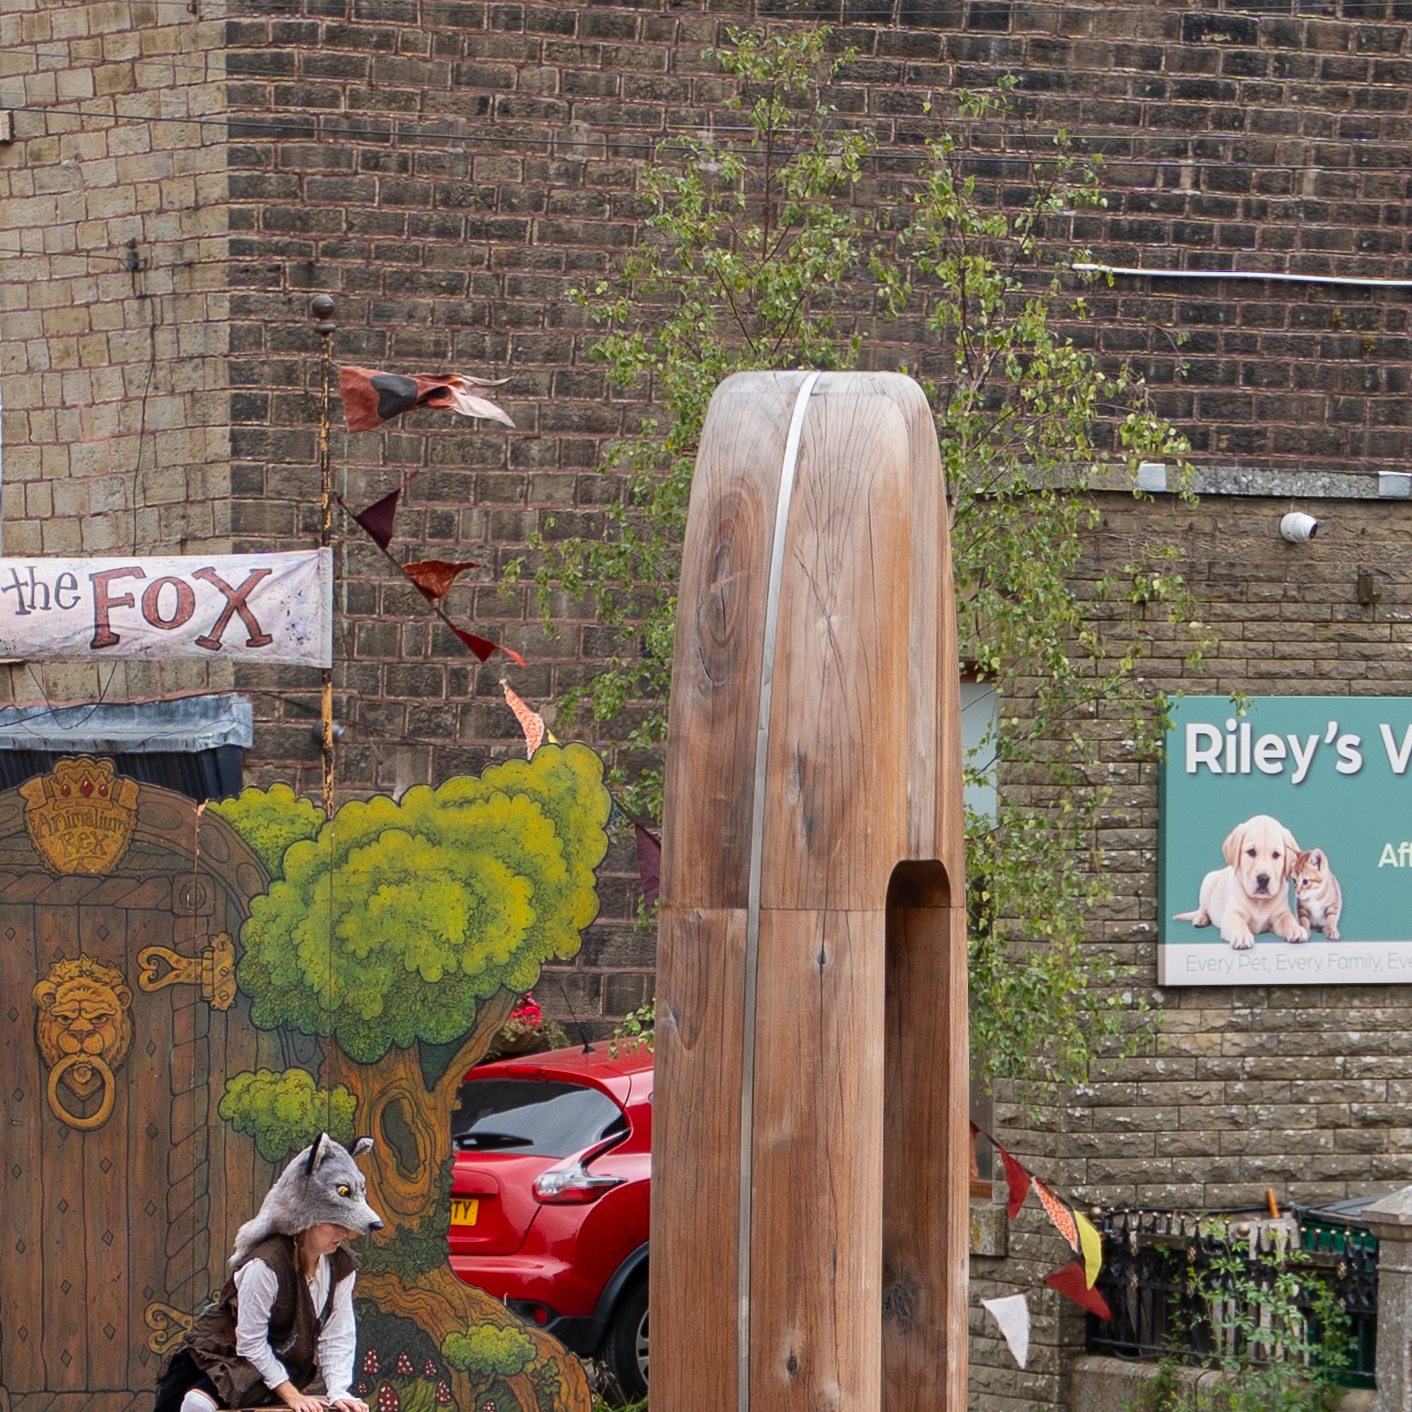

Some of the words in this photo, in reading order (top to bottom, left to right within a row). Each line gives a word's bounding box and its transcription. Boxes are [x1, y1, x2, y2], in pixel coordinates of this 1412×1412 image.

[0, 565, 82, 616] the
[60, 831, 108, 859] Rex
[1185, 954, 1235, 974] Every
[1238, 953, 1272, 973] Pet,
[1275, 953, 1324, 973] Every
[1327, 952, 1384, 972] Family,
